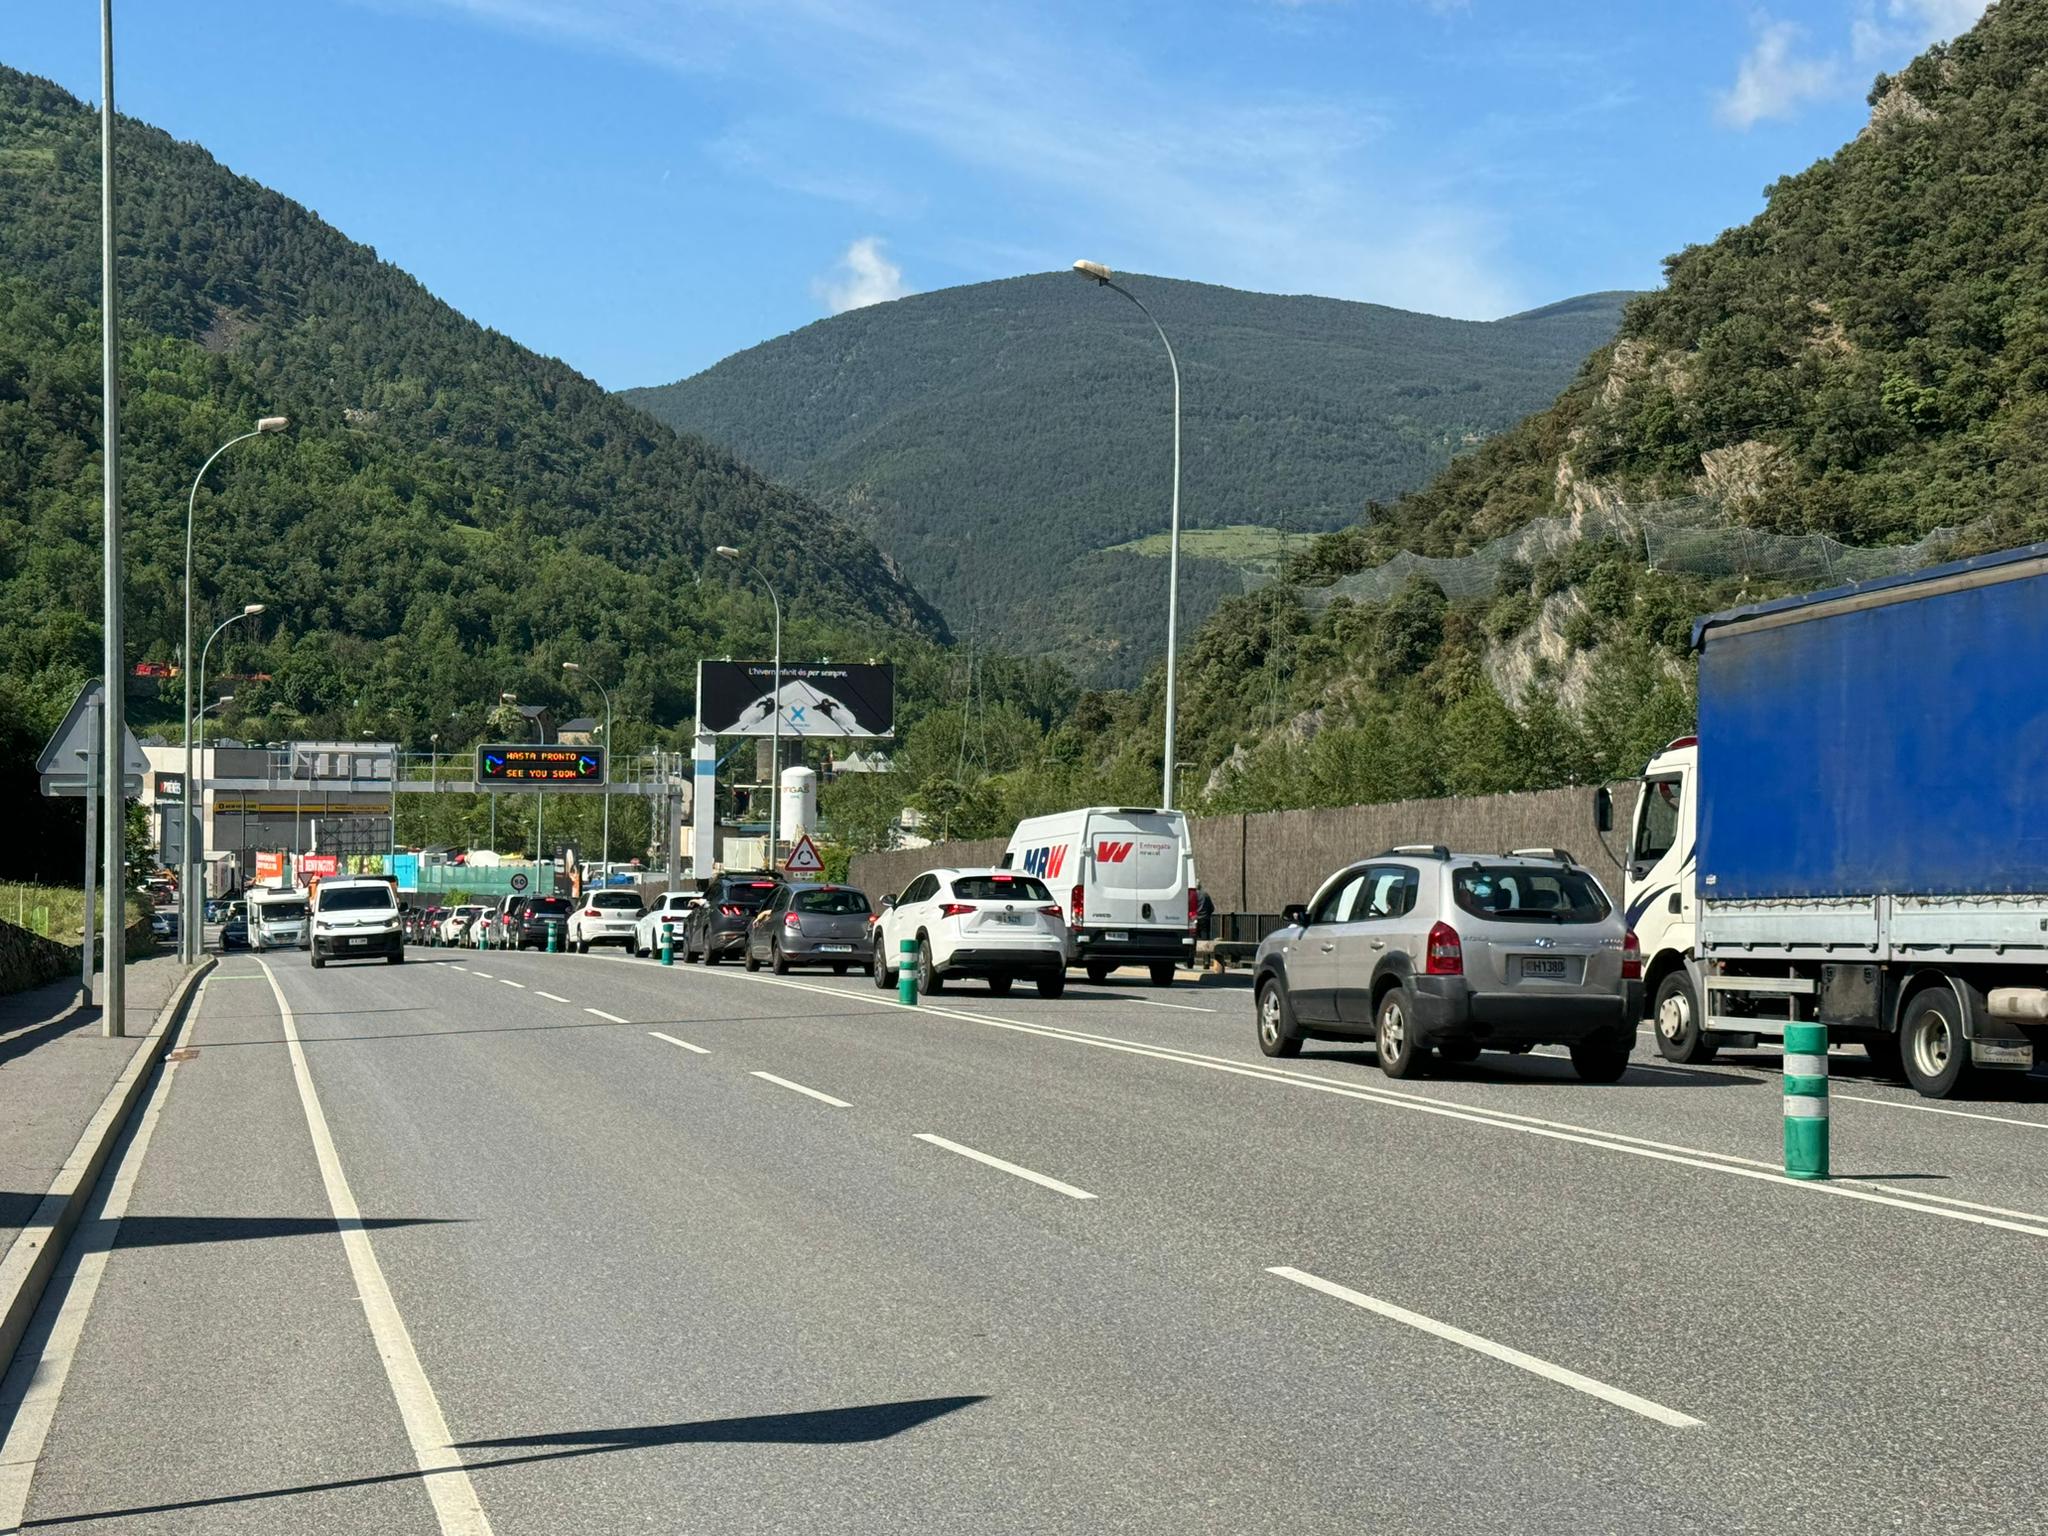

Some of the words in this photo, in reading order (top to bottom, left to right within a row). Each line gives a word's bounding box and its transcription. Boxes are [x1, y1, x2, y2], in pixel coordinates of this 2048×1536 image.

[779, 667, 797, 676] nfinit
[807, 669, 819, 678] per
[506, 752, 537, 760] HASTA
[541, 752, 577, 760] PRONTO
[506, 769, 524, 778] SEE
[529, 769, 548, 778] YOU
[552, 769, 577, 778] SOON
[1023, 844, 1068, 879] MRW
